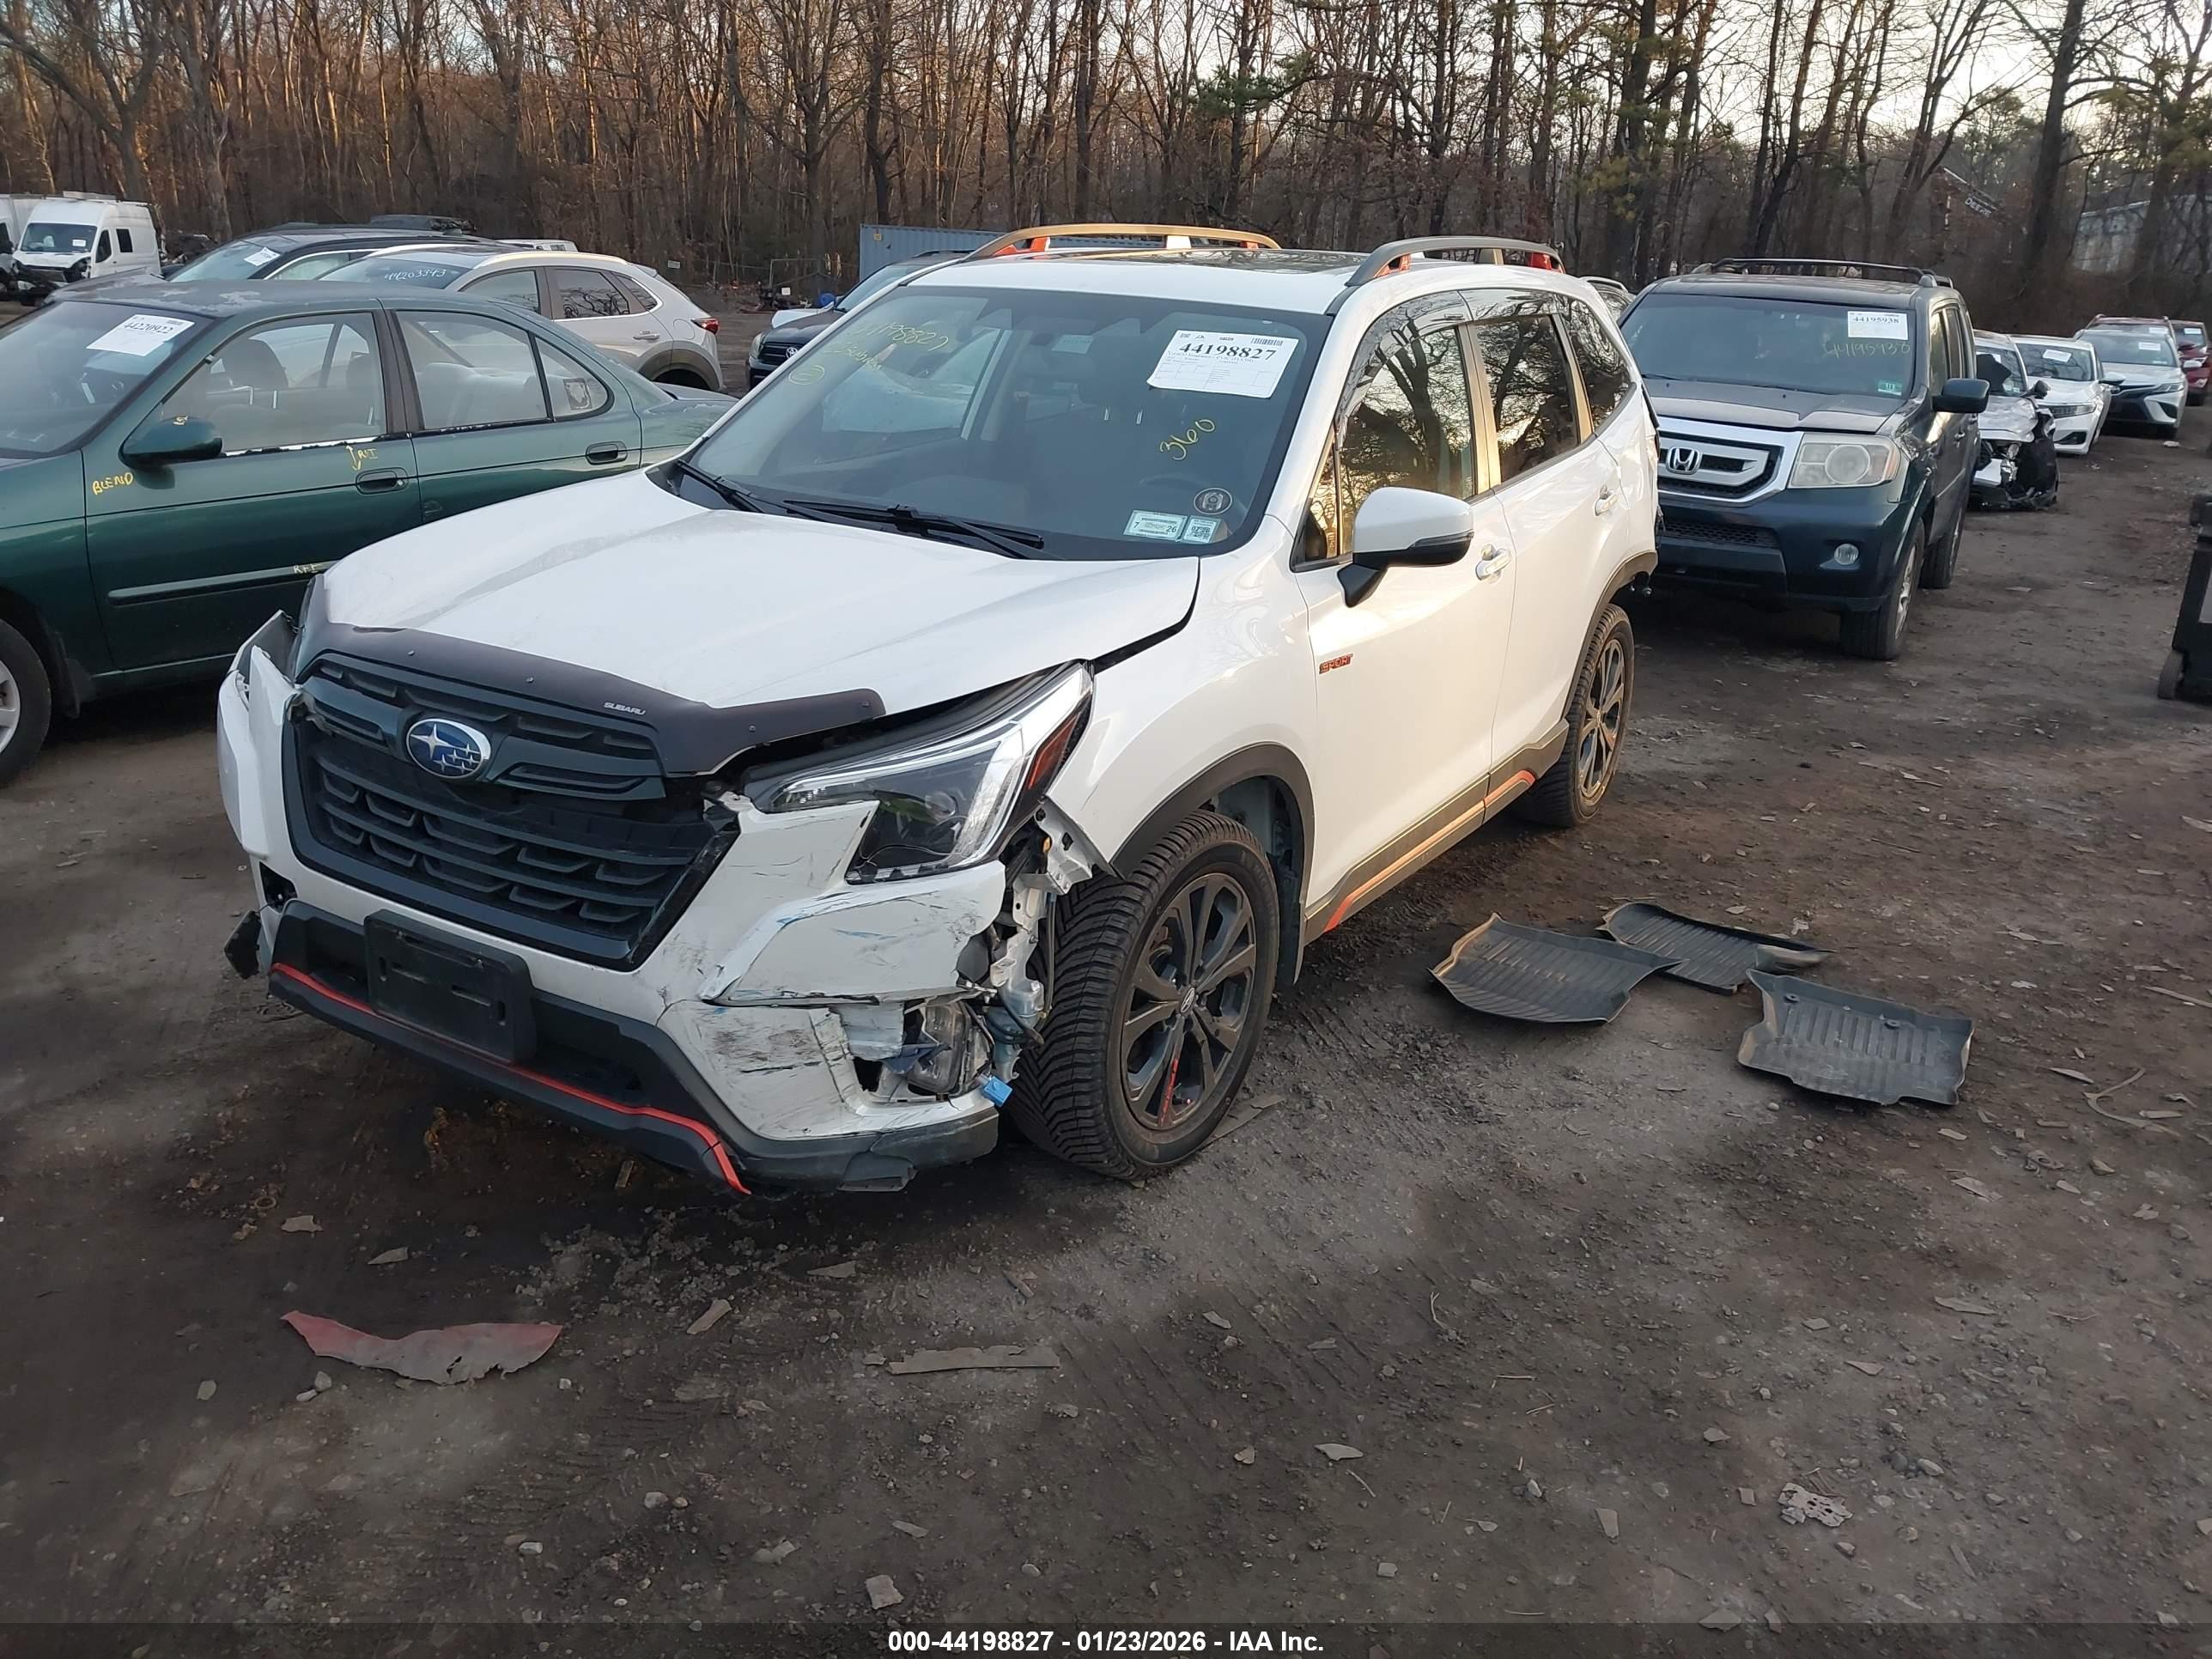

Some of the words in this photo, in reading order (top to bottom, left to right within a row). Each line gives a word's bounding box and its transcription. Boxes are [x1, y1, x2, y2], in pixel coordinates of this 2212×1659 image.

[1179, 343, 1277, 361] 44198827
[1159, 419, 1216, 461] 360
[92, 472, 134, 495] BLEND
[1319, 653, 1353, 674] SPORT
[604, 702, 647, 715] SUBARU
